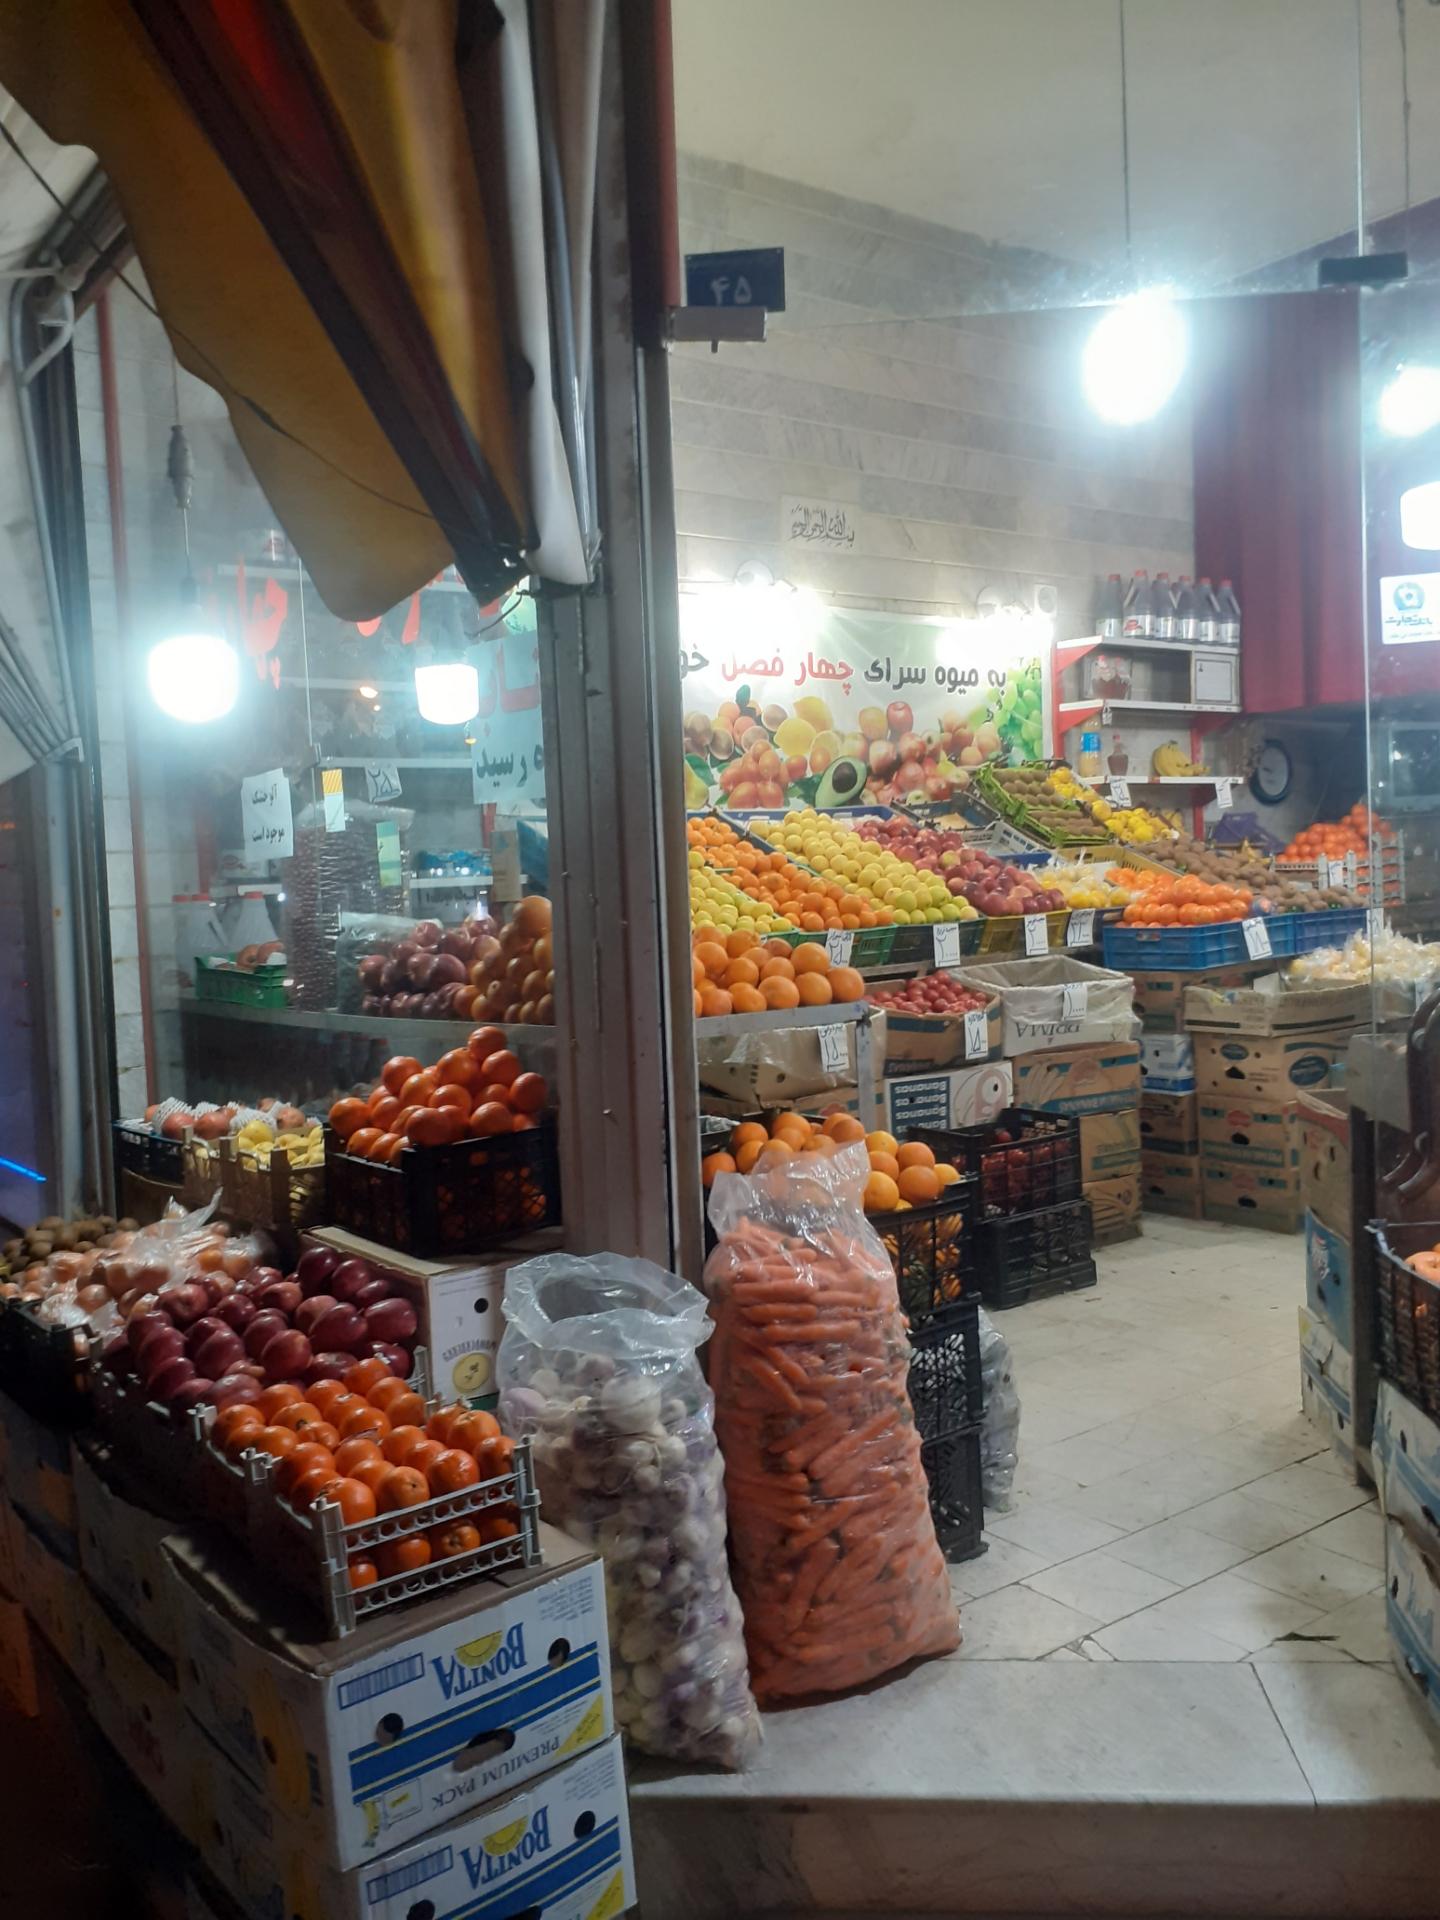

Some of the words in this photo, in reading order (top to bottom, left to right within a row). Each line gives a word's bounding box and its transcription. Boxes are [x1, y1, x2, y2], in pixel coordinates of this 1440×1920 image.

[721, 647, 785, 682] فصل
[794, 651, 854, 696] چهار
[863, 656, 927, 691] سرای
[934, 665, 979, 695] میوه
[987, 668, 1007, 696] به
[895, 1080, 947, 1094] Bananas
[895, 1106, 947, 1120] Bananas
[431, 1621, 527, 1702] BONITA
[481, 1735, 561, 1789] PREMIUM
[431, 1777, 477, 1810] PACK
[459, 1804, 552, 1891] BONITA
